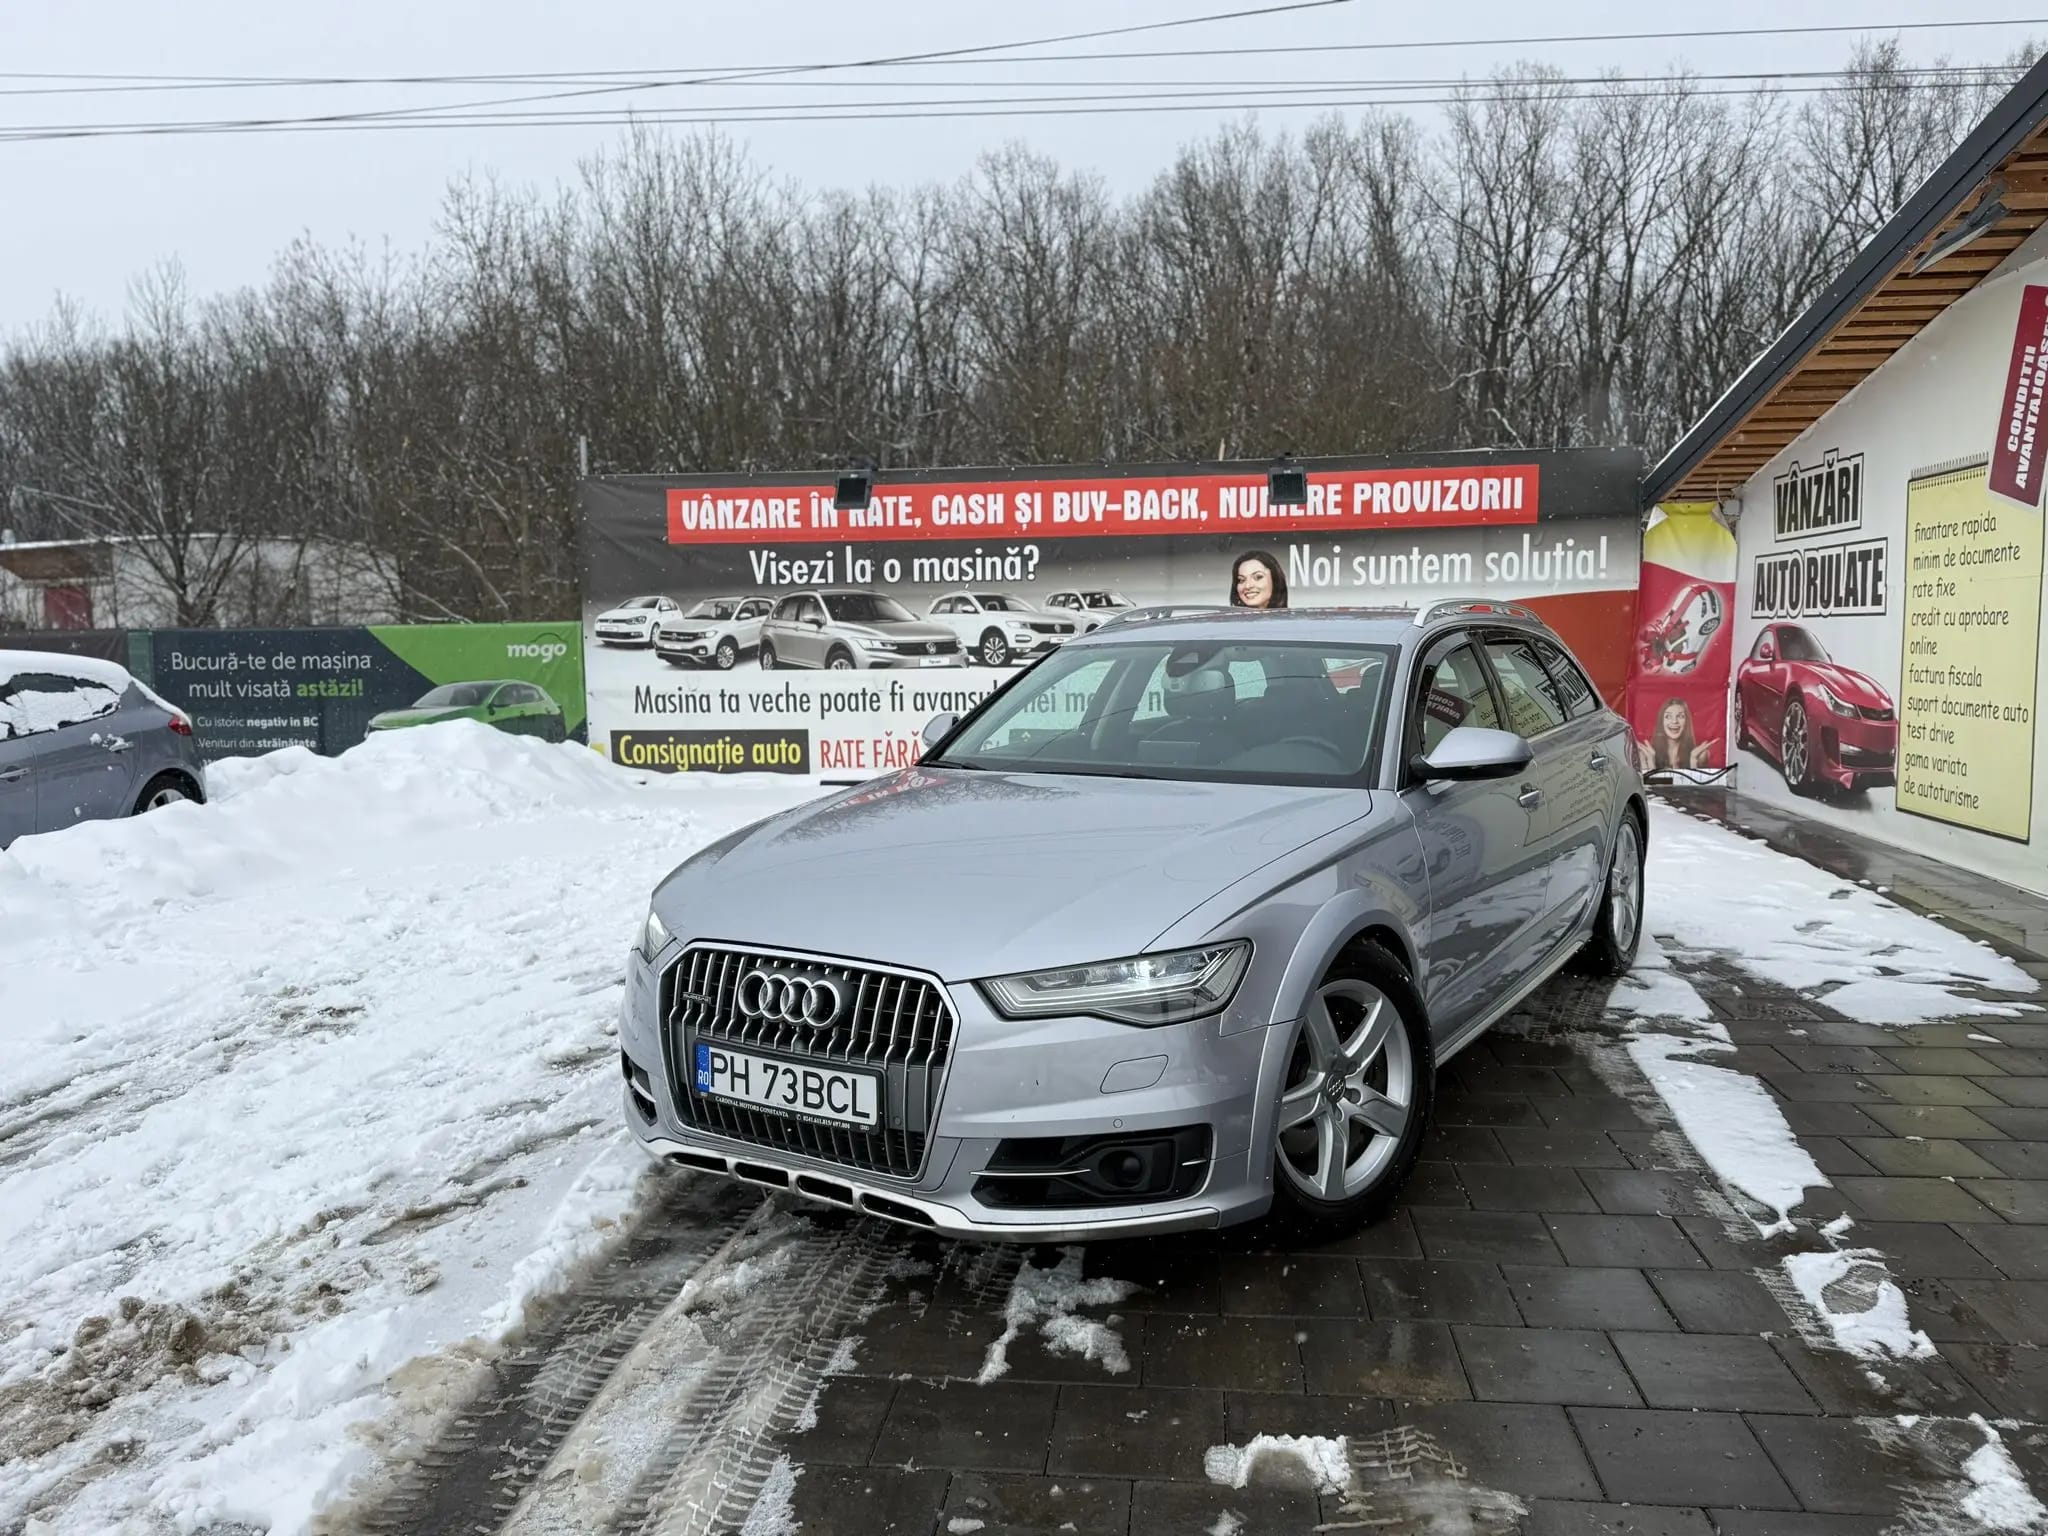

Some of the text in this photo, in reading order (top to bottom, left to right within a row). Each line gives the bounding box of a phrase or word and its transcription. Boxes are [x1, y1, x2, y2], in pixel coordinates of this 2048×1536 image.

[2007, 345, 2036, 452] CONDITII
[682, 493, 801, 530] VÂNZARE
[810, 491, 838, 528] ÎN
[931, 493, 1004, 525] CASH
[1014, 492, 1042, 531] ȘI
[1053, 488, 1208, 523] BUY-BACK,
[1353, 477, 1523, 515] PROVIZORII
[1776, 457, 1860, 535] VÂNZĂRI
[1914, 510, 1997, 543] finantare rapida
[749, 544, 1040, 589] Visezi la o mașină?
[1289, 544, 1341, 588] Noi
[1352, 546, 1472, 586] suntem
[1913, 541, 2021, 571] minim de documente
[1754, 547, 1884, 612] AUTO RULATE
[1912, 577, 1956, 598] rate fixe
[1911, 604, 2009, 632] credit cu aprobare
[507, 643, 567, 663] mogo
[1909, 635, 1938, 655] online
[171, 651, 371, 673] Bucură-te de mașina
[1908, 663, 1983, 688] factura fiscala
[189, 678, 364, 698] mult visată astăzi!
[634, 684, 712, 714] Masina
[719, 688, 741, 714] ta
[748, 681, 811, 714] veche
[820, 687, 881, 720] poate
[889, 680, 905, 712] fi
[197, 716, 212, 727] Cu
[214, 716, 245, 727] istoric
[246, 717, 288, 730] negativ
[303, 716, 319, 727] BC
[1907, 693, 2029, 723] suport documente auto
[198, 738, 237, 748] Venituri
[238, 738, 255, 748] din
[1907, 721, 1955, 745] test drive
[619, 734, 801, 772] Consignație auto
[820, 731, 922, 769] RATE FĂRĂ
[1904, 752, 1968, 777] gama variata
[1903, 775, 1980, 810] de autoturisme
[698, 1069, 709, 1086] RO
[710, 1051, 871, 1119] PH 73BCL
